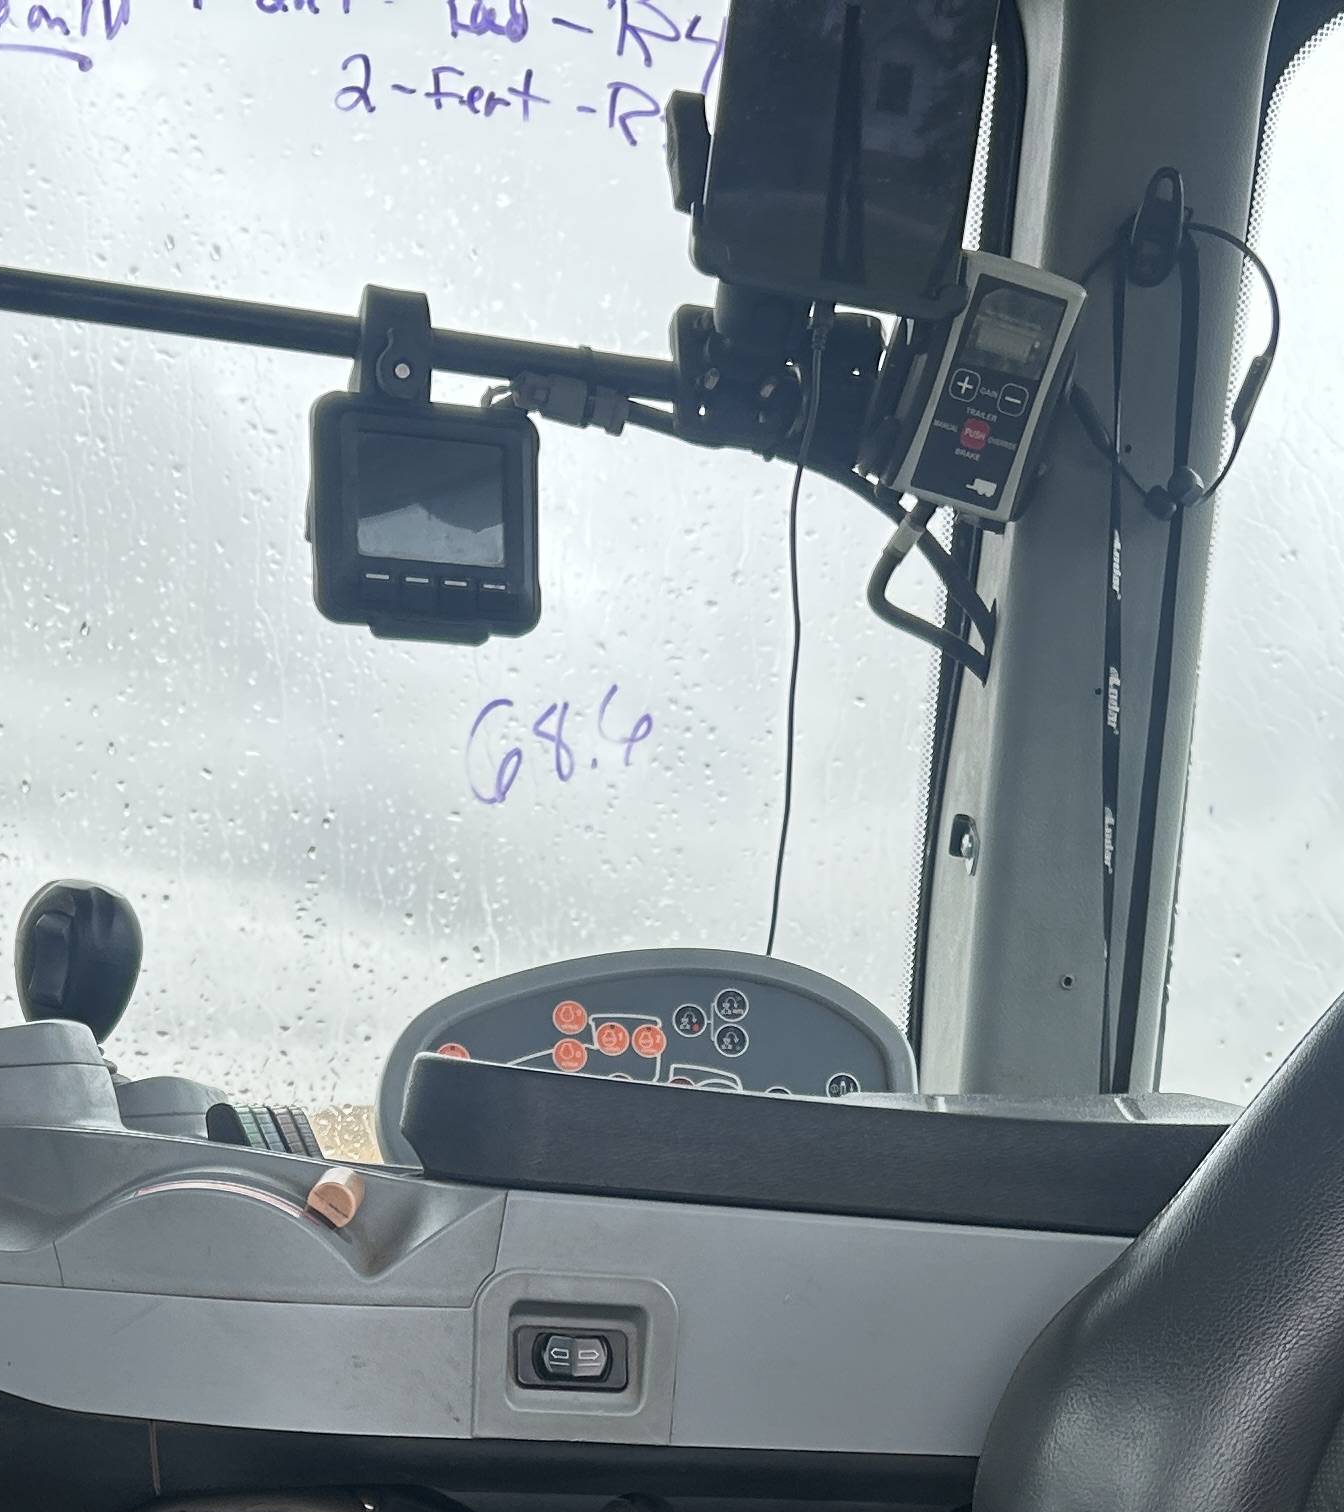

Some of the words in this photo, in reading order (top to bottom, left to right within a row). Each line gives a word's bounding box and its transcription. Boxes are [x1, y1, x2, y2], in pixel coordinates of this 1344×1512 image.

[979, 386, 998, 398] GAIN
[966, 406, 997, 422] TRAILER
[964, 427, 986, 440] PUSH
[954, 448, 981, 462] BRAKE
[466, 685, 653, 804] 68.6
